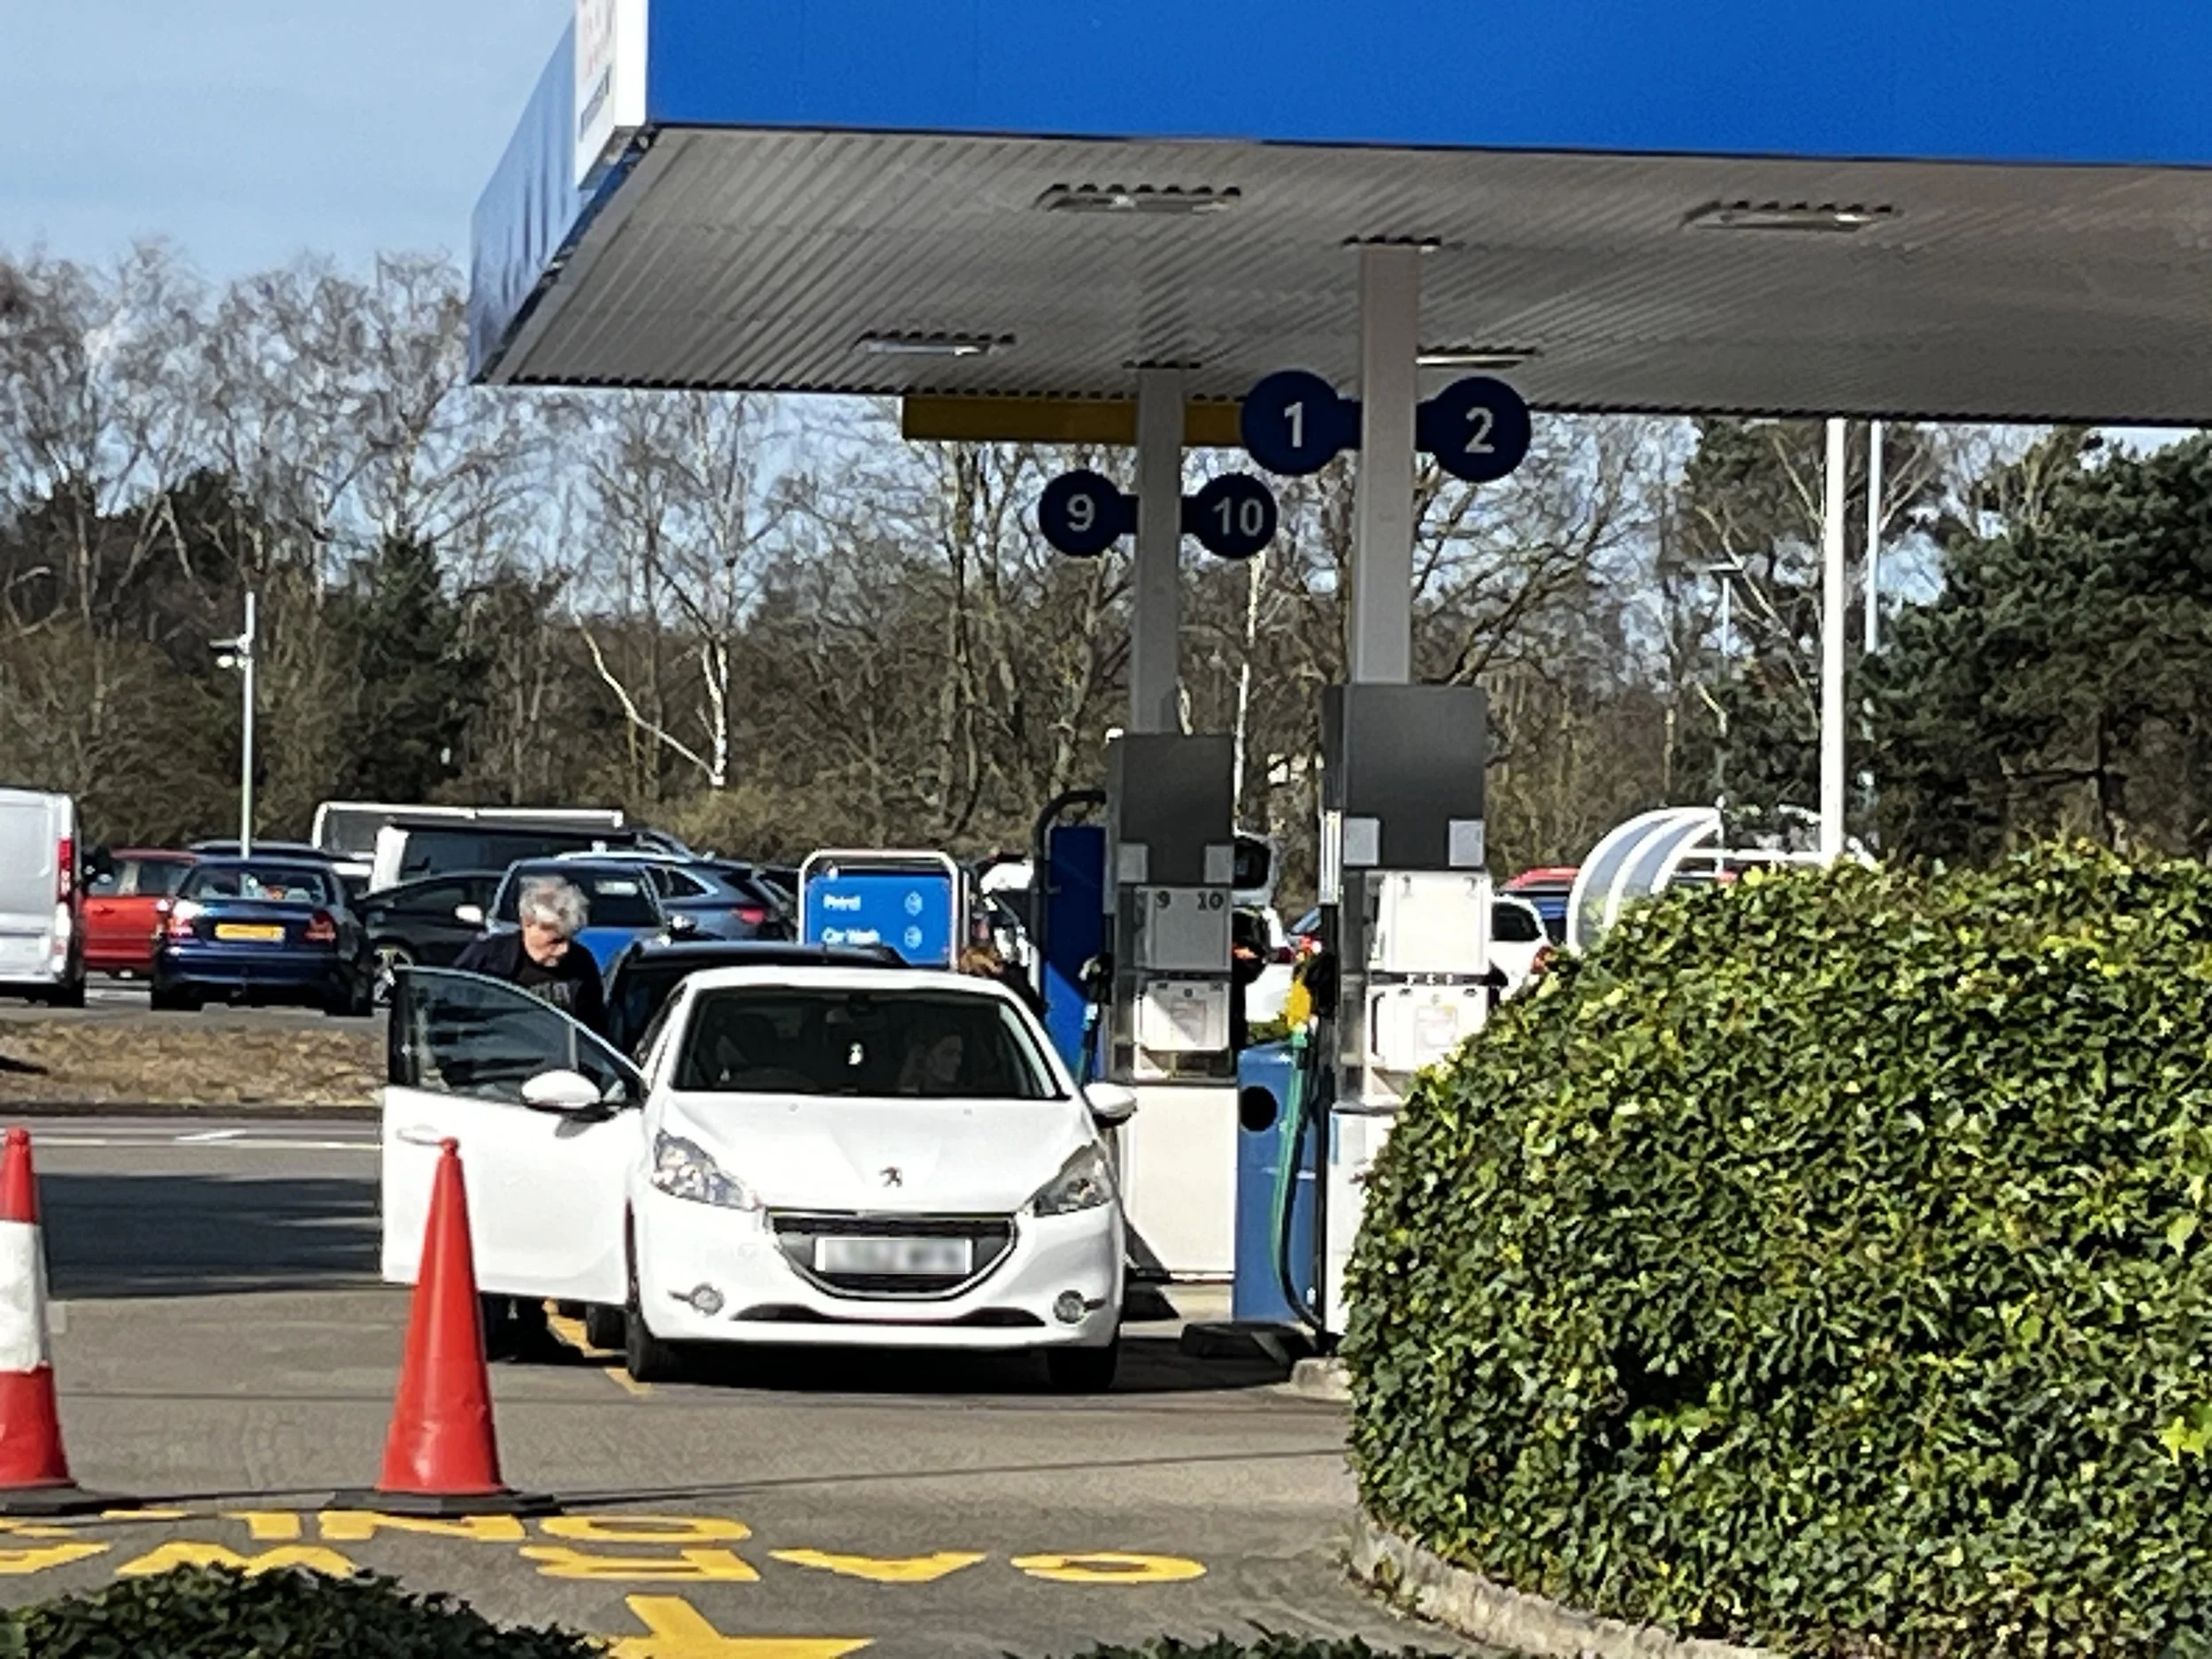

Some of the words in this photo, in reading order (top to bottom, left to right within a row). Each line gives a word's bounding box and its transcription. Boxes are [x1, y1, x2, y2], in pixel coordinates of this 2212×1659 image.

[1283, 401, 1305, 449] 1
[1463, 407, 1495, 455] 2
[1065, 493, 1096, 532] 9
[1212, 497, 1264, 537] 10
[1156, 890, 1171, 910] 9
[1196, 890, 1225, 911] 10
[518, 1545, 1209, 1584] CAR
